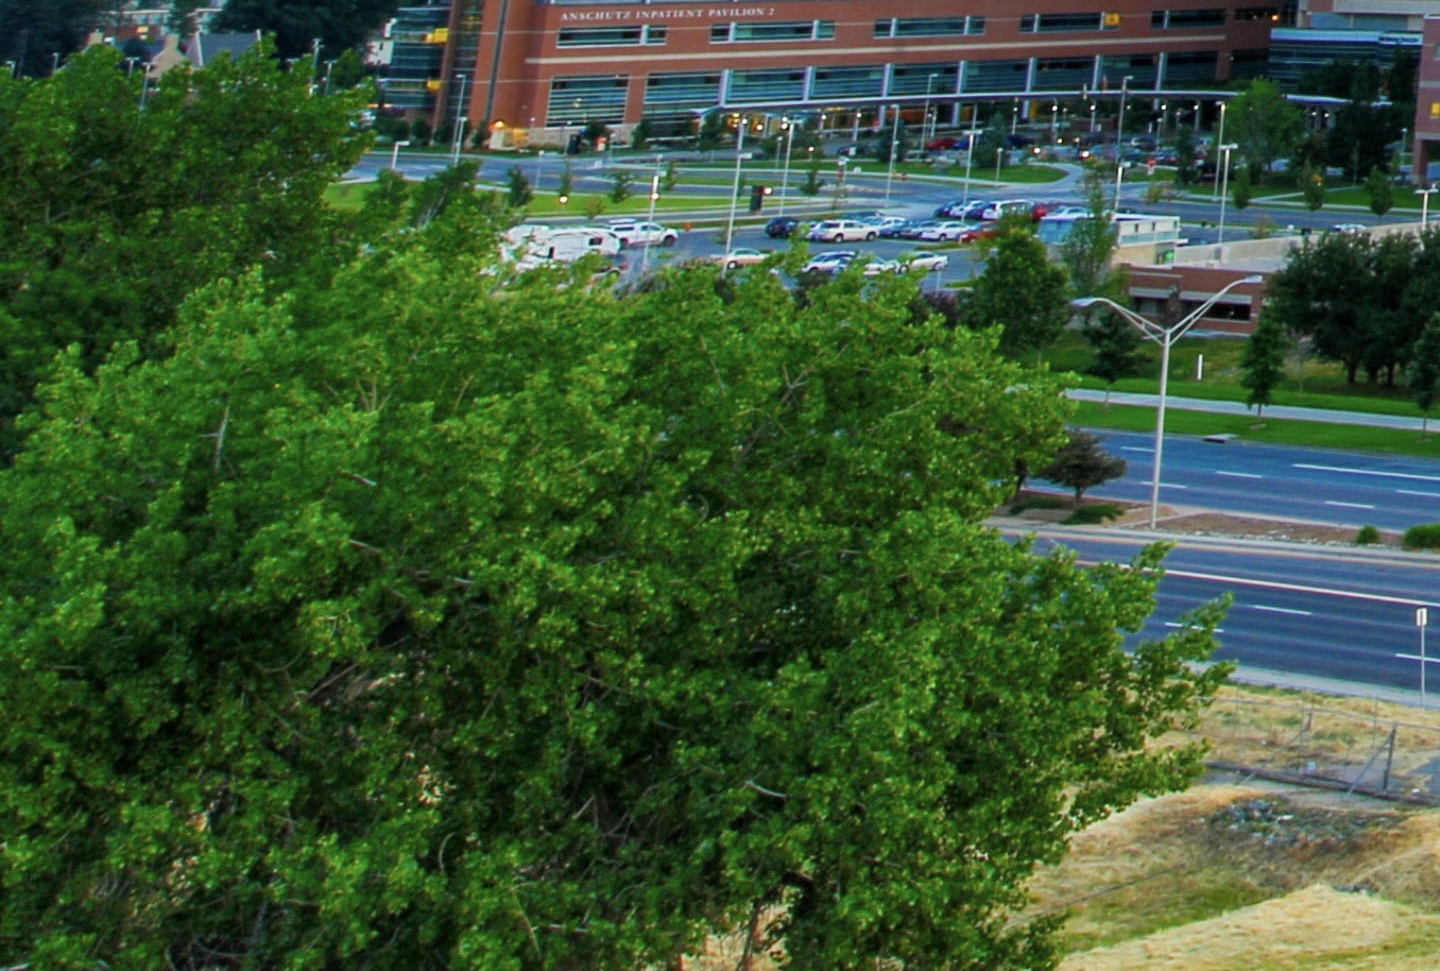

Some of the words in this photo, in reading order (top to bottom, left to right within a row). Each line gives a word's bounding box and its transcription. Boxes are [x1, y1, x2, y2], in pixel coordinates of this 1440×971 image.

[561, 10, 632, 21] ANSCHUTZ
[635, 9, 705, 19] INPATIENT
[708, 7, 765, 17] PAVILION
[768, 7, 776, 16] 2
